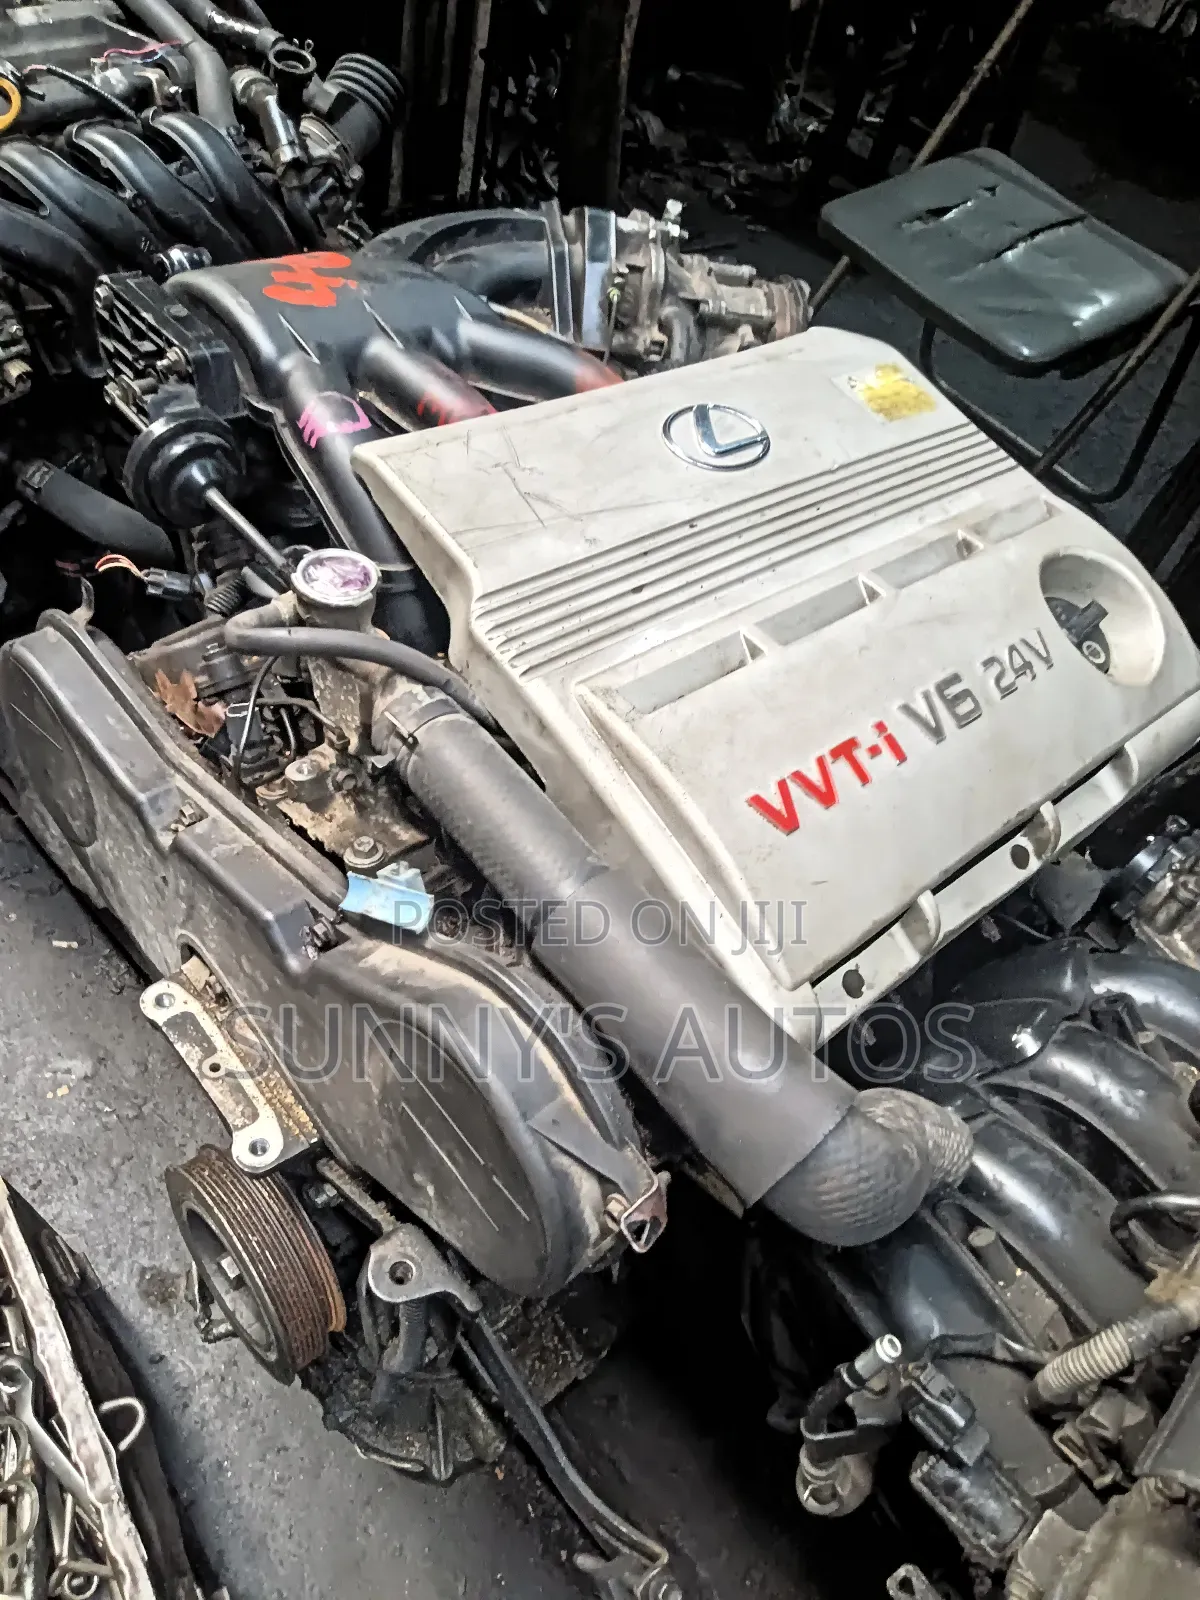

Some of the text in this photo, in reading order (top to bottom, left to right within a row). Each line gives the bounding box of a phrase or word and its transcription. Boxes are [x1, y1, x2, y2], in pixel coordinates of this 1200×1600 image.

[745, 627, 1055, 836] VVT-i V6 24V
